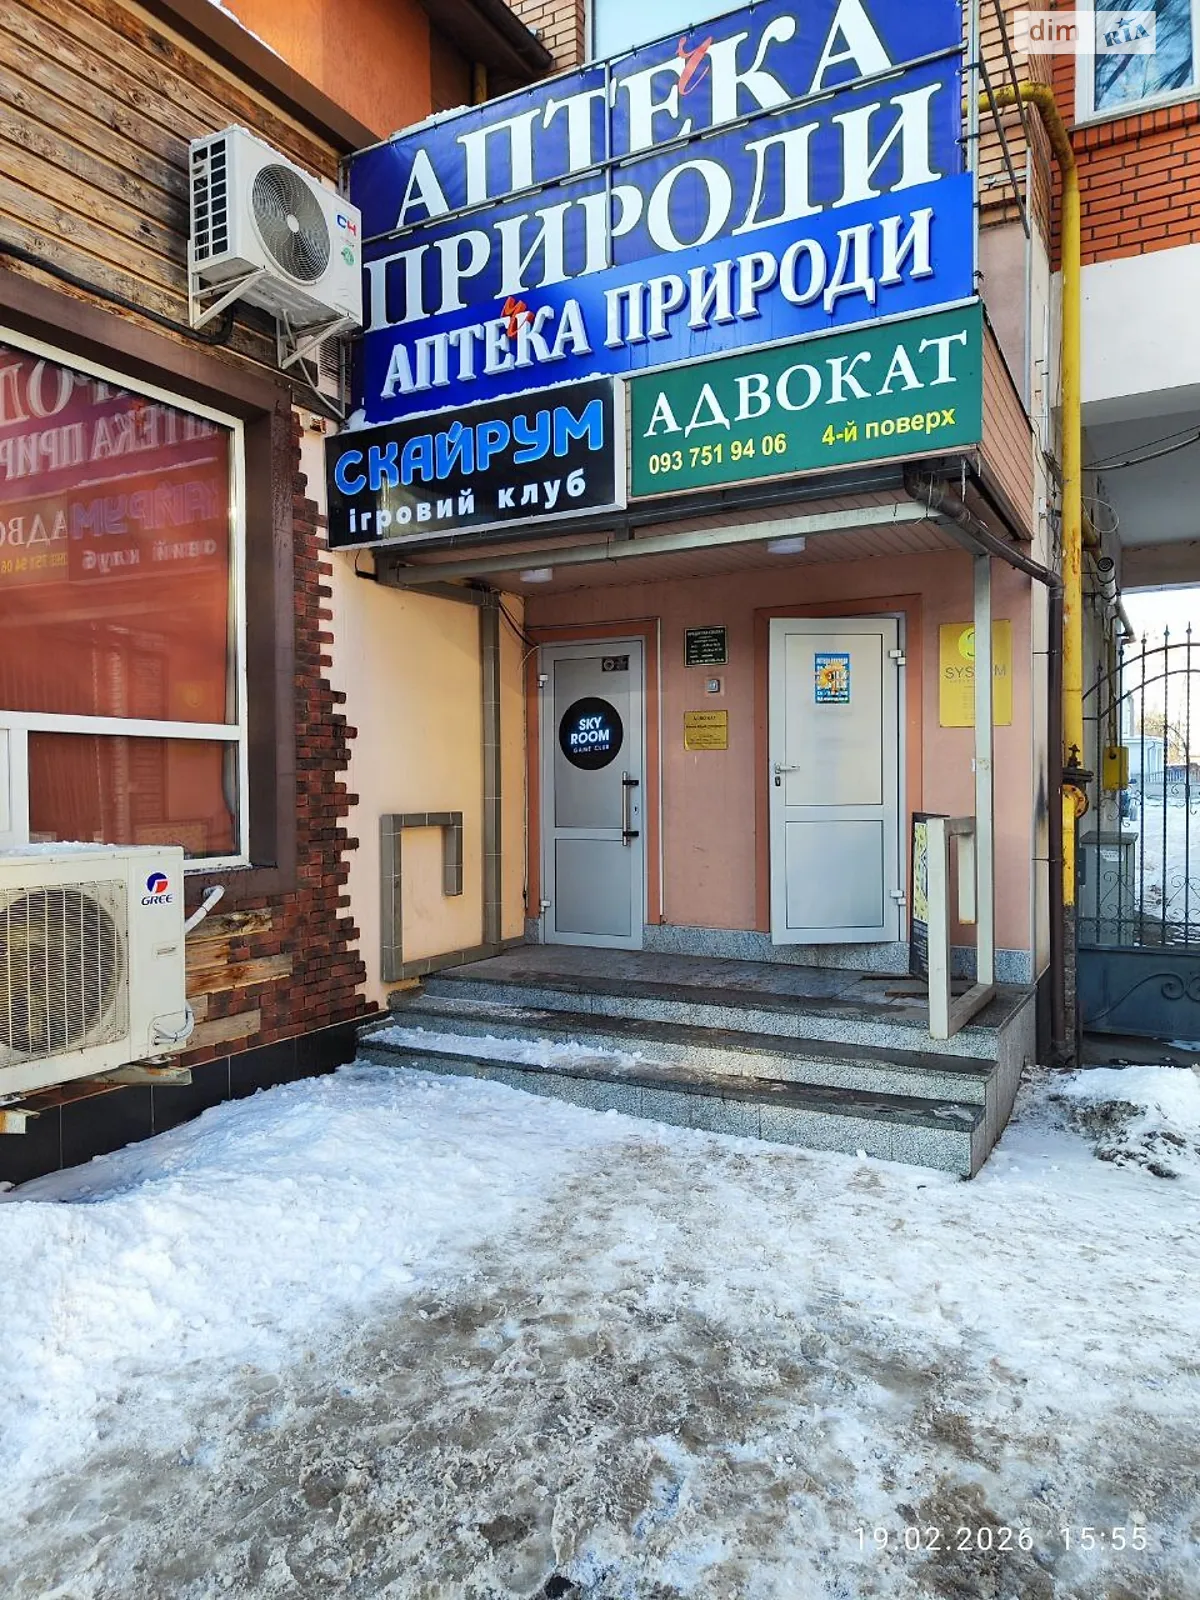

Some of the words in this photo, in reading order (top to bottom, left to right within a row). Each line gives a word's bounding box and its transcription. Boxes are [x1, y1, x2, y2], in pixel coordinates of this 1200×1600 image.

[363, 83, 941, 331] ПРИРОДИ
[604, 207, 934, 348] ПРИРОДИ
[643, 330, 968, 438] АДВОКАТ
[822, 422, 859, 446] 4-й
[865, 406, 956, 440] поверх
[334, 399, 604, 496] СКАЙРУМ
[649, 451, 683, 475] 093
[689, 443, 724, 468] 751
[730, 439, 756, 462] 94
[761, 433, 787, 457] 06
[349, 487, 476, 537] ігровий
[498, 468, 587, 511] клуб
[944, 665, 1006, 680] SYSM
[570, 729, 610, 745] ROOM
[578, 716, 602, 730] SKY
[141, 894, 173, 906] GREE
